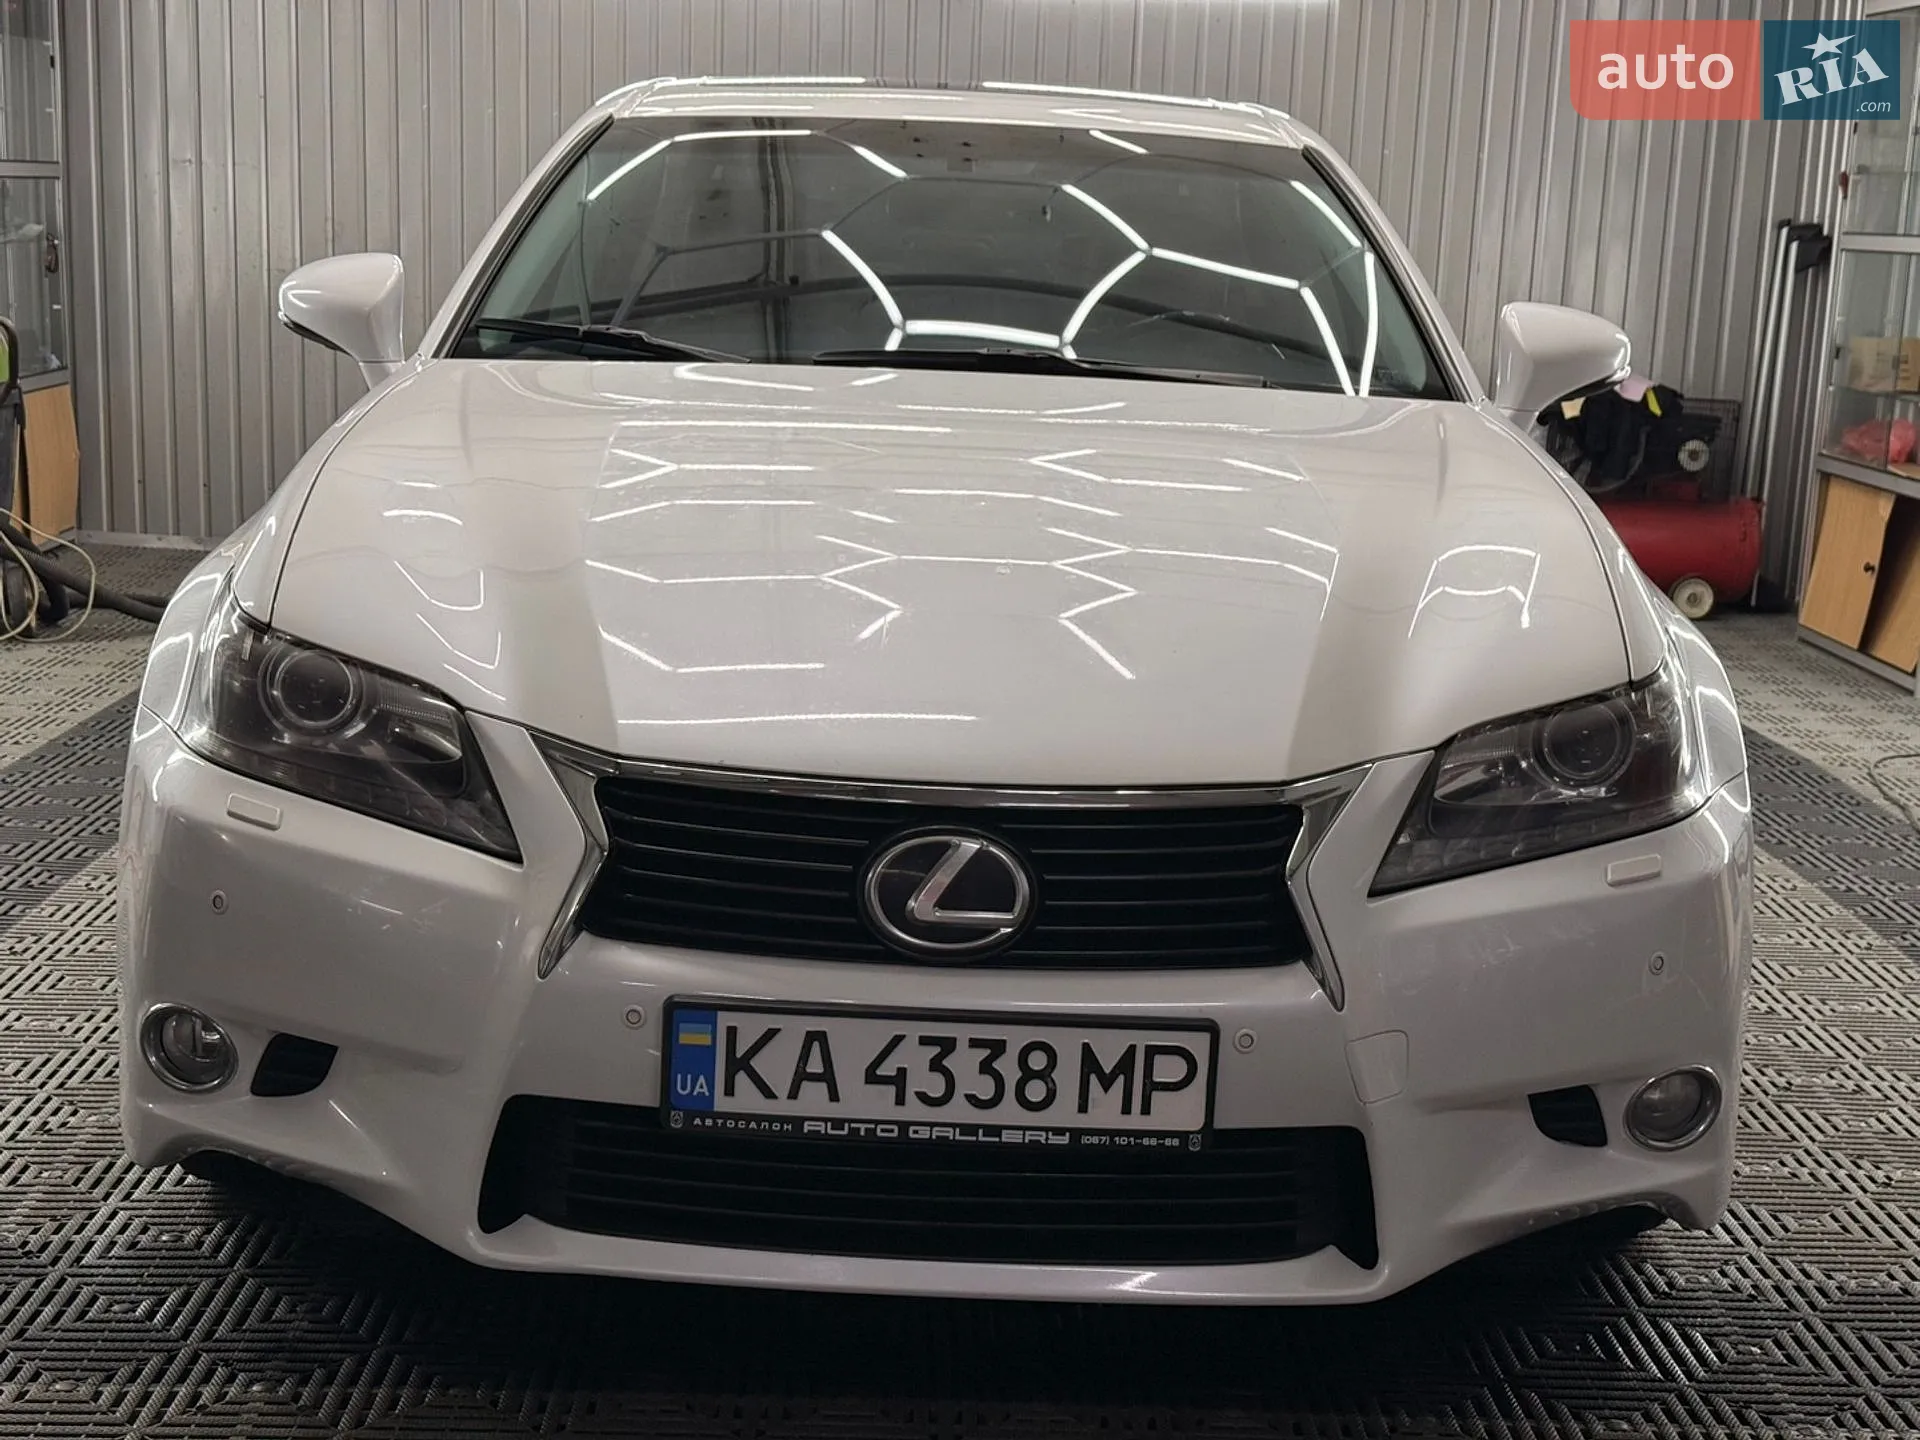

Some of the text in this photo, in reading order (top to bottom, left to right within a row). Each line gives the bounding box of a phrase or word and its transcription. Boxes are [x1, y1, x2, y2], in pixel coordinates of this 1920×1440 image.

[723, 1025, 1198, 1116] KA 4338 MP
[676, 1074, 710, 1097] UA
[693, 1117, 793, 1132] АВТОСАЛОН
[803, 1120, 1070, 1145] AUTO GALLERY
